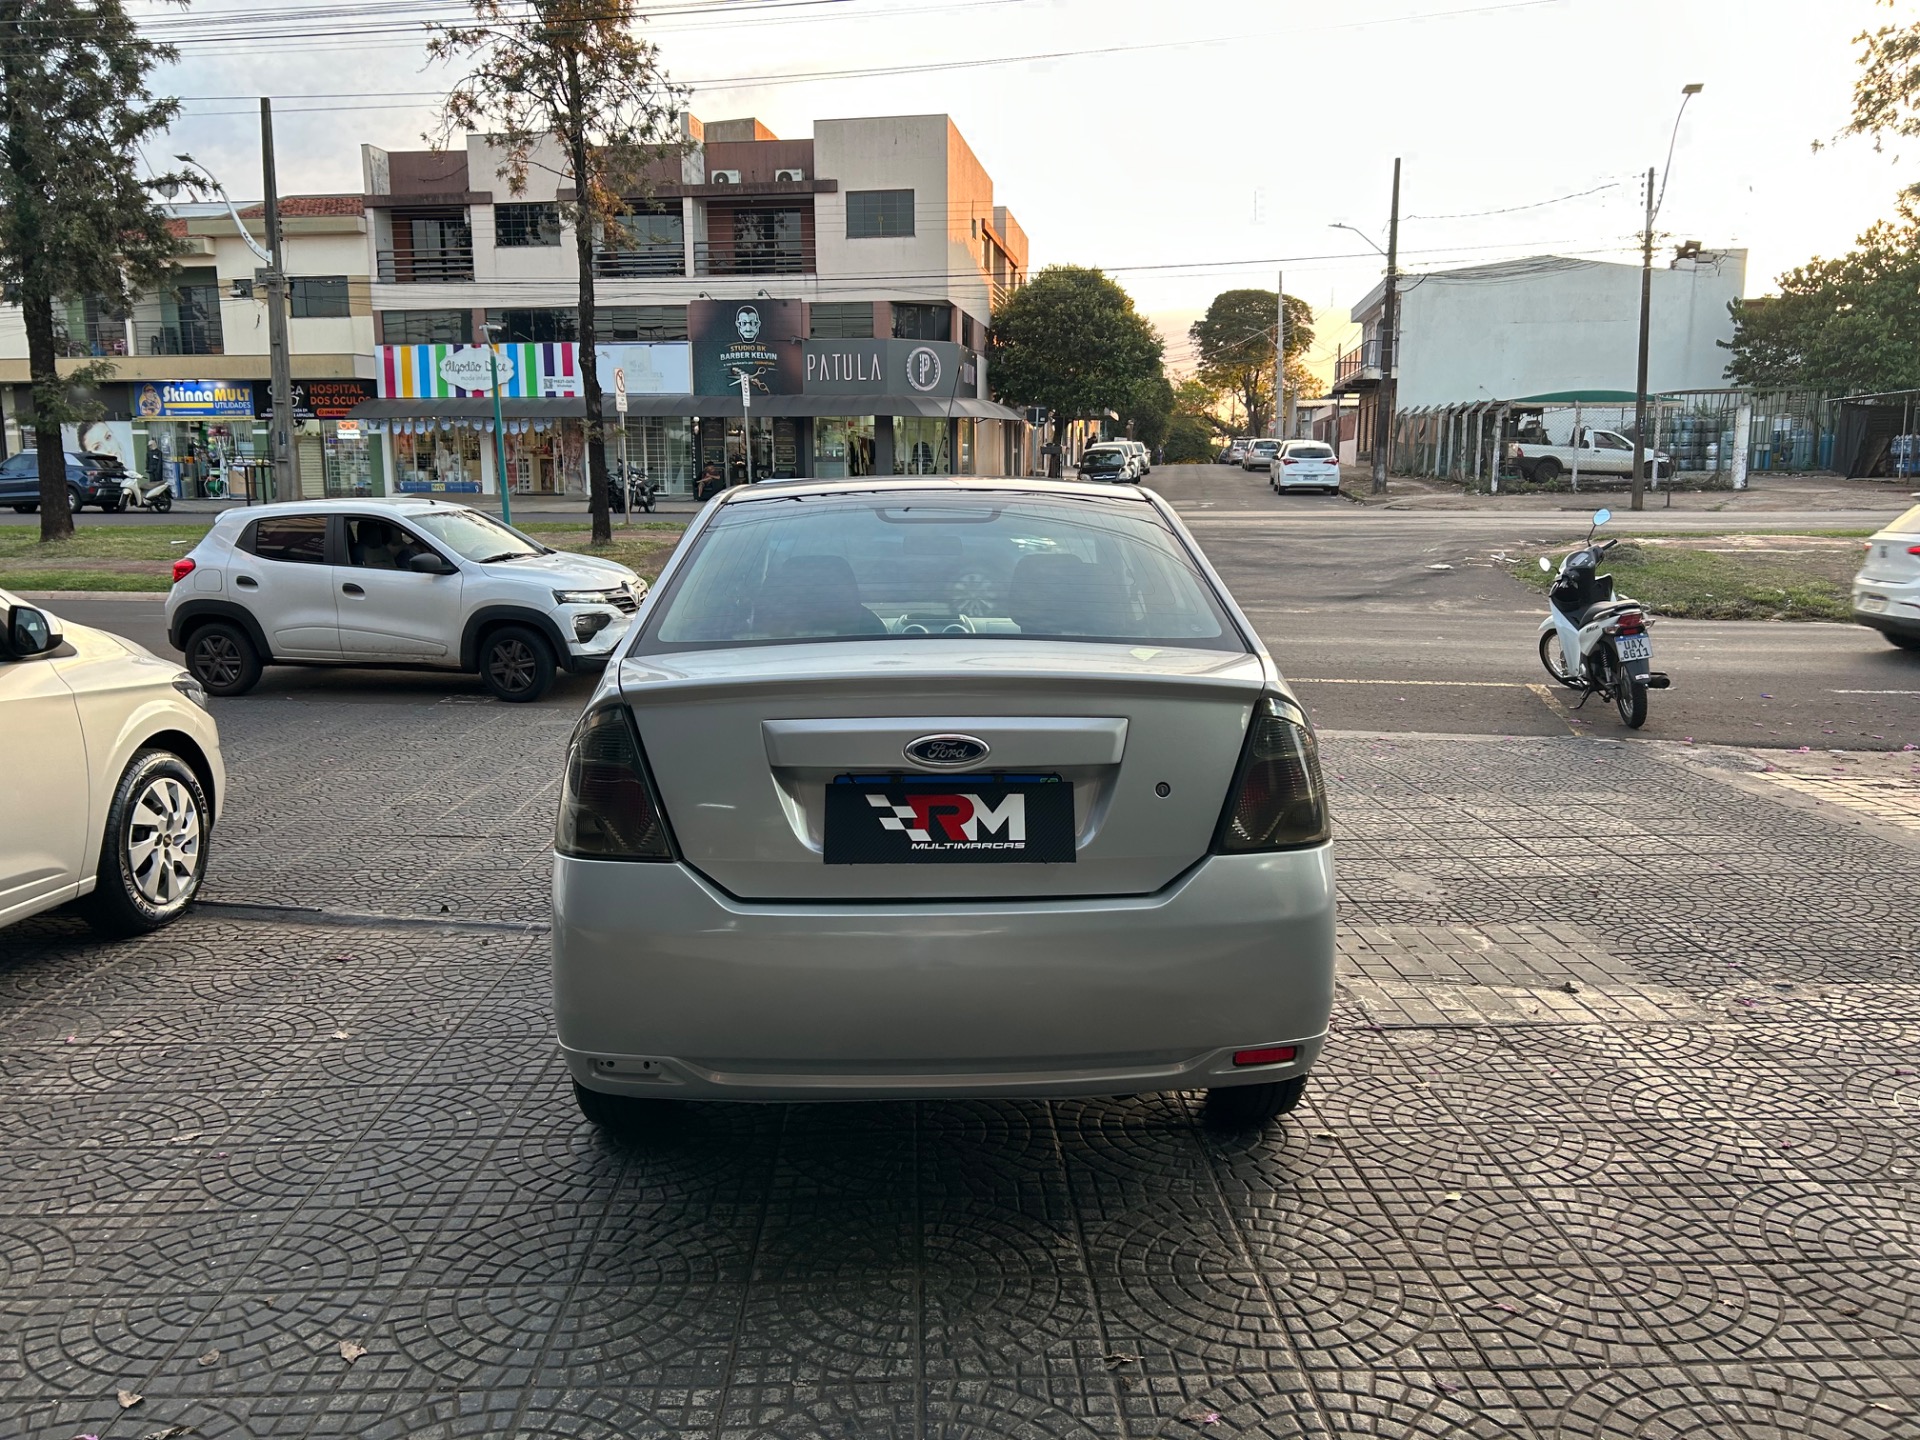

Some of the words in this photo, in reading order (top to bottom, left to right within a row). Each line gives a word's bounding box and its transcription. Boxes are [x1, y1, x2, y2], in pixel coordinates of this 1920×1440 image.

[720, 351, 750, 360] BARBER
[751, 351, 778, 360] KELVIN
[485, 361, 508, 373] Dce
[806, 353, 883, 381] PATULA
[309, 384, 364, 394] HOSPITAL
[310, 396, 331, 405] DOS
[1623, 638, 1644, 650] UAX
[1623, 647, 1650, 659] 8G11
[927, 741, 968, 759] Ford
[911, 842, 1026, 850] MULTIMARCAS
